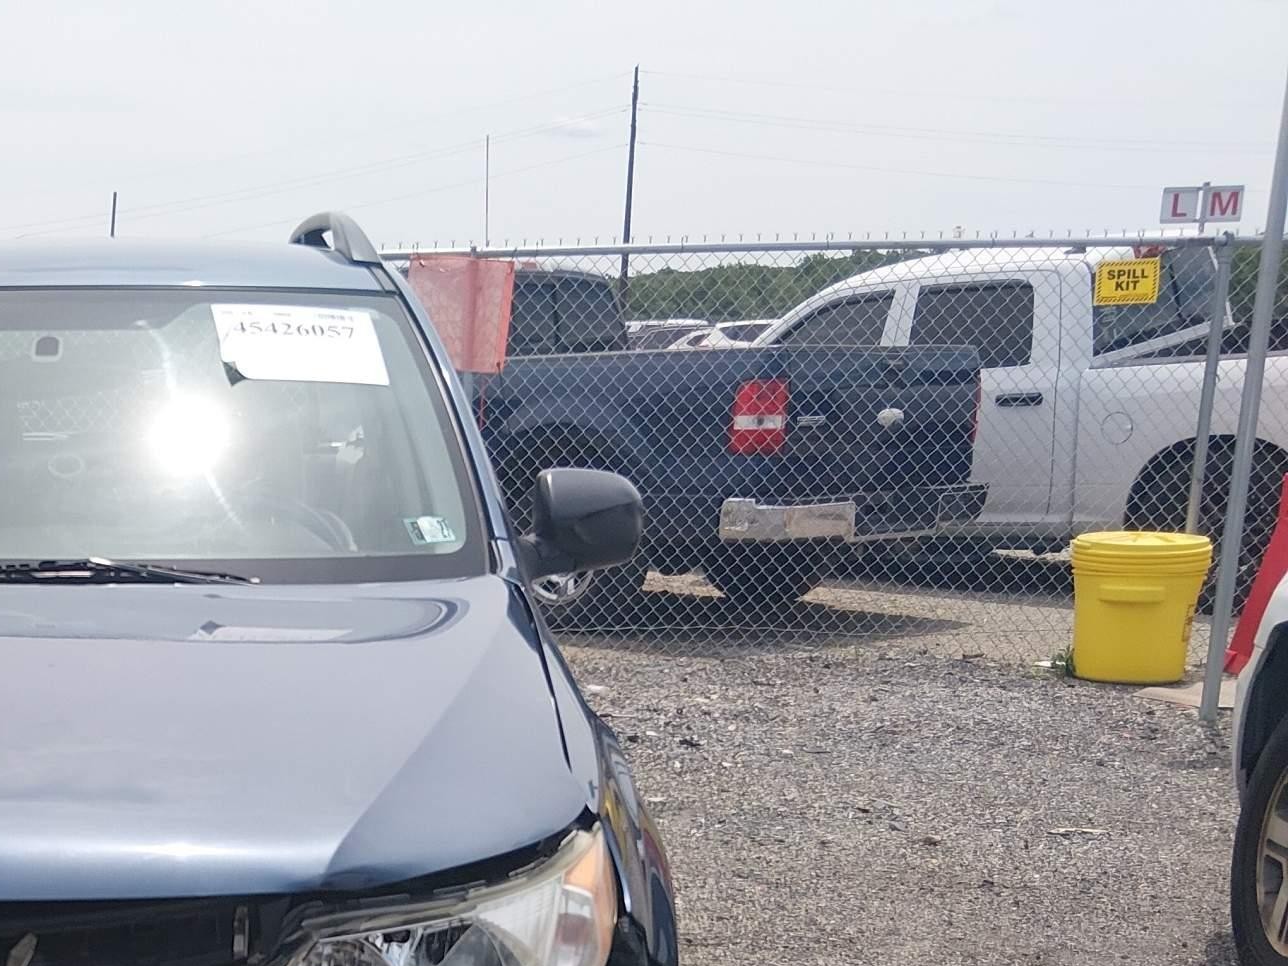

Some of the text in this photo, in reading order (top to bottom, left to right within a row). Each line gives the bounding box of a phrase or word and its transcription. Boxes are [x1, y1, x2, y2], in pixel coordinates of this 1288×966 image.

[1171, 193, 1187, 217] L
[1209, 191, 1240, 217] M
[1107, 268, 1149, 281] SPILL
[1114, 279, 1140, 292] KIT
[232, 320, 355, 340] 45426057
